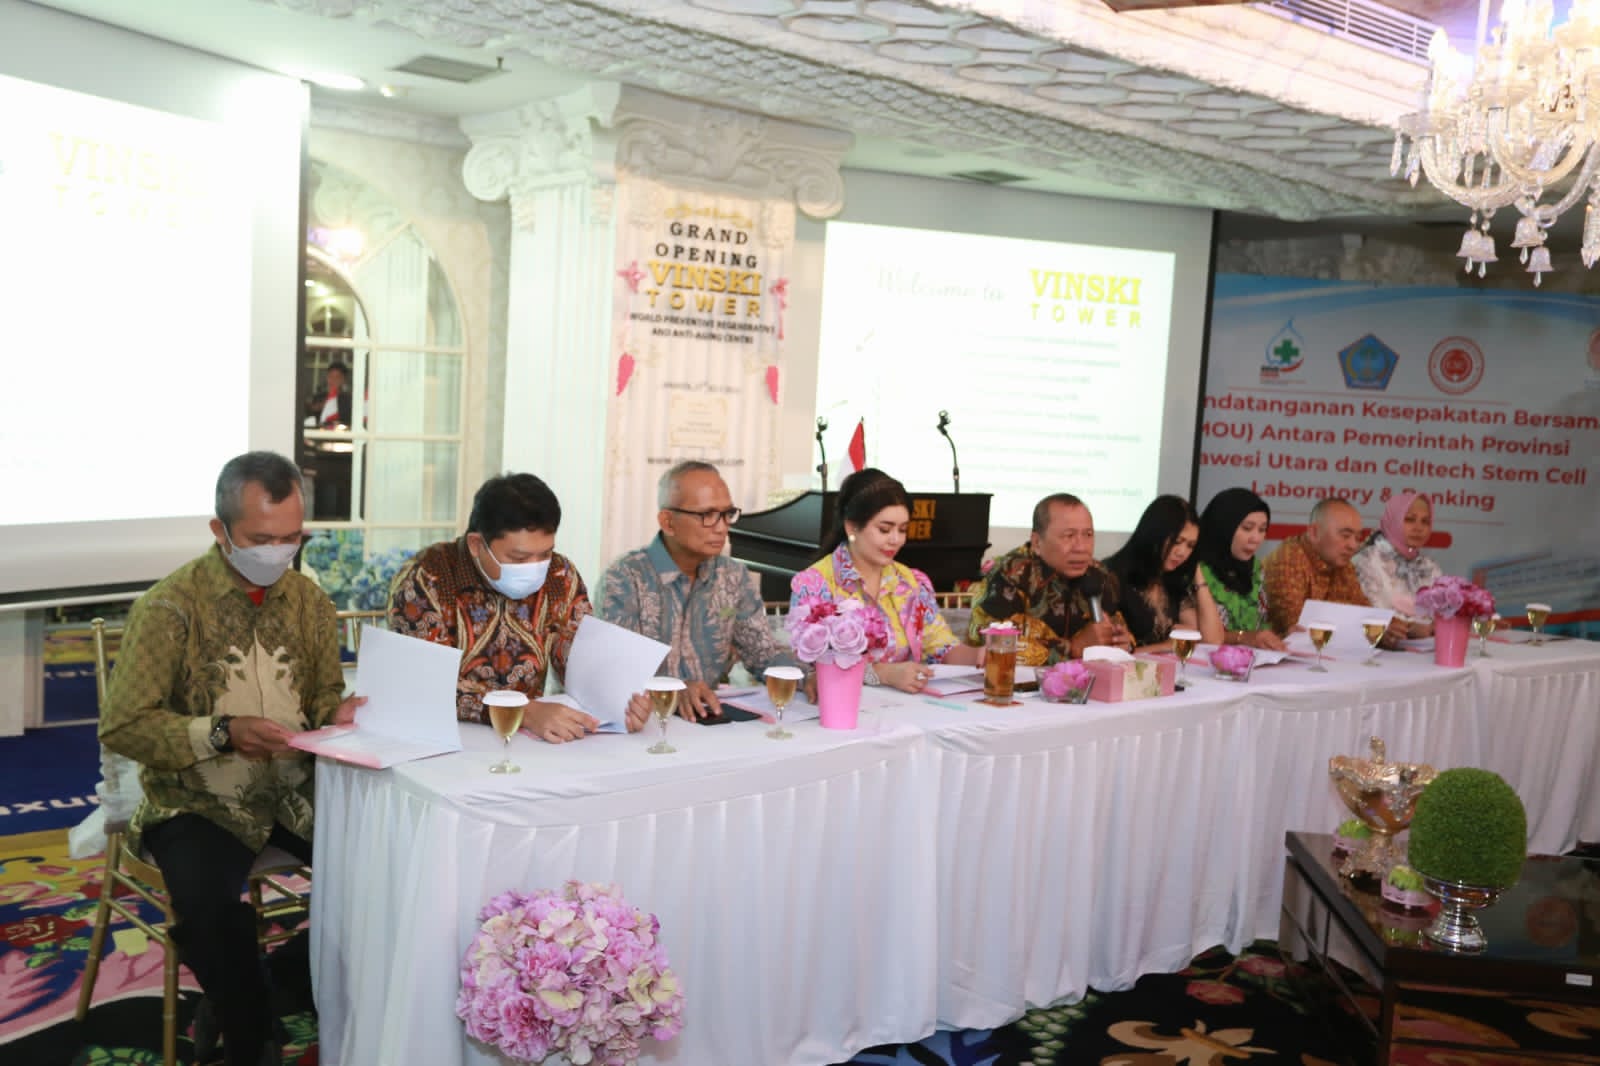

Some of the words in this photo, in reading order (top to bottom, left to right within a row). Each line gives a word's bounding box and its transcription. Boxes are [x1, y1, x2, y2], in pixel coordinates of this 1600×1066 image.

[48, 131, 206, 195] VINS
[670, 221, 748, 245] GRAND
[655, 242, 758, 269] OPENING
[648, 260, 762, 296] VINSKI
[1028, 268, 1142, 306] VINSKI
[645, 288, 760, 318] TOWER
[1029, 303, 1142, 329] TOWER
[630, 312, 662, 323] WORLD
[663, 315, 715, 329] PREVENTIVE
[652, 328, 671, 337] AND
[1203, 391, 1355, 417] ndatanganan
[1362, 401, 1506, 425] Kesepakatan
[1513, 409, 1600, 430] Bersam
[1260, 424, 1336, 444] Antara
[1343, 428, 1475, 451] Pemerintah
[1481, 435, 1572, 457] Provinsi
[1268, 452, 1328, 472] Utara
[1335, 456, 1378, 475] dan
[1384, 458, 1475, 480] Celltech
[1482, 464, 1539, 483] Stem
[1546, 466, 1588, 486] Cell
[1251, 479, 1373, 504] Laboratory
[1402, 487, 1495, 512] nking
